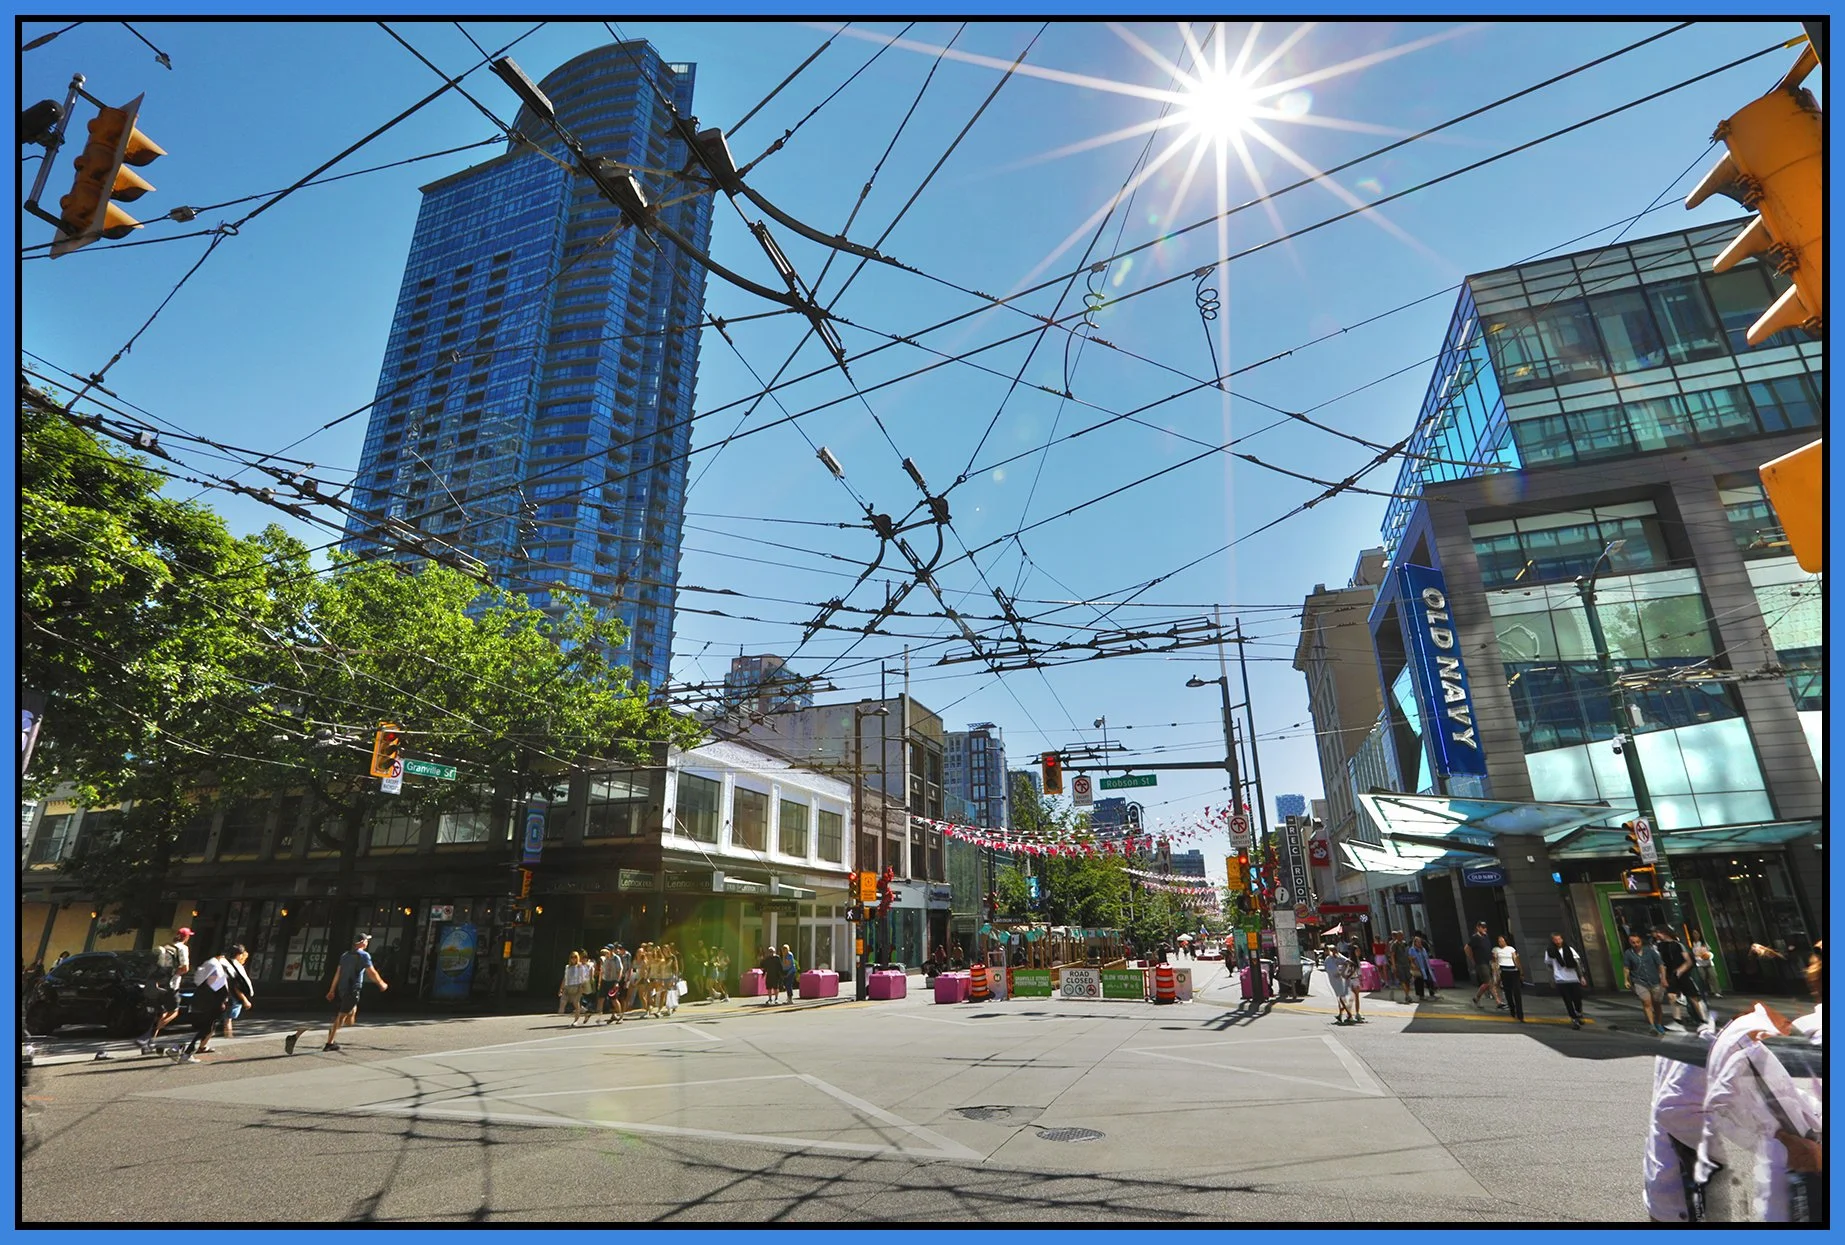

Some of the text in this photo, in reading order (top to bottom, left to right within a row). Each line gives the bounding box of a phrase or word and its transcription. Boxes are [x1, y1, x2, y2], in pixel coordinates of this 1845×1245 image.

[1422, 587, 1477, 749] OLD NAVY
[406, 761, 454, 778] Granville St
[1106, 777, 1150, 788] Robson St
[1289, 827, 1299, 854] REC
